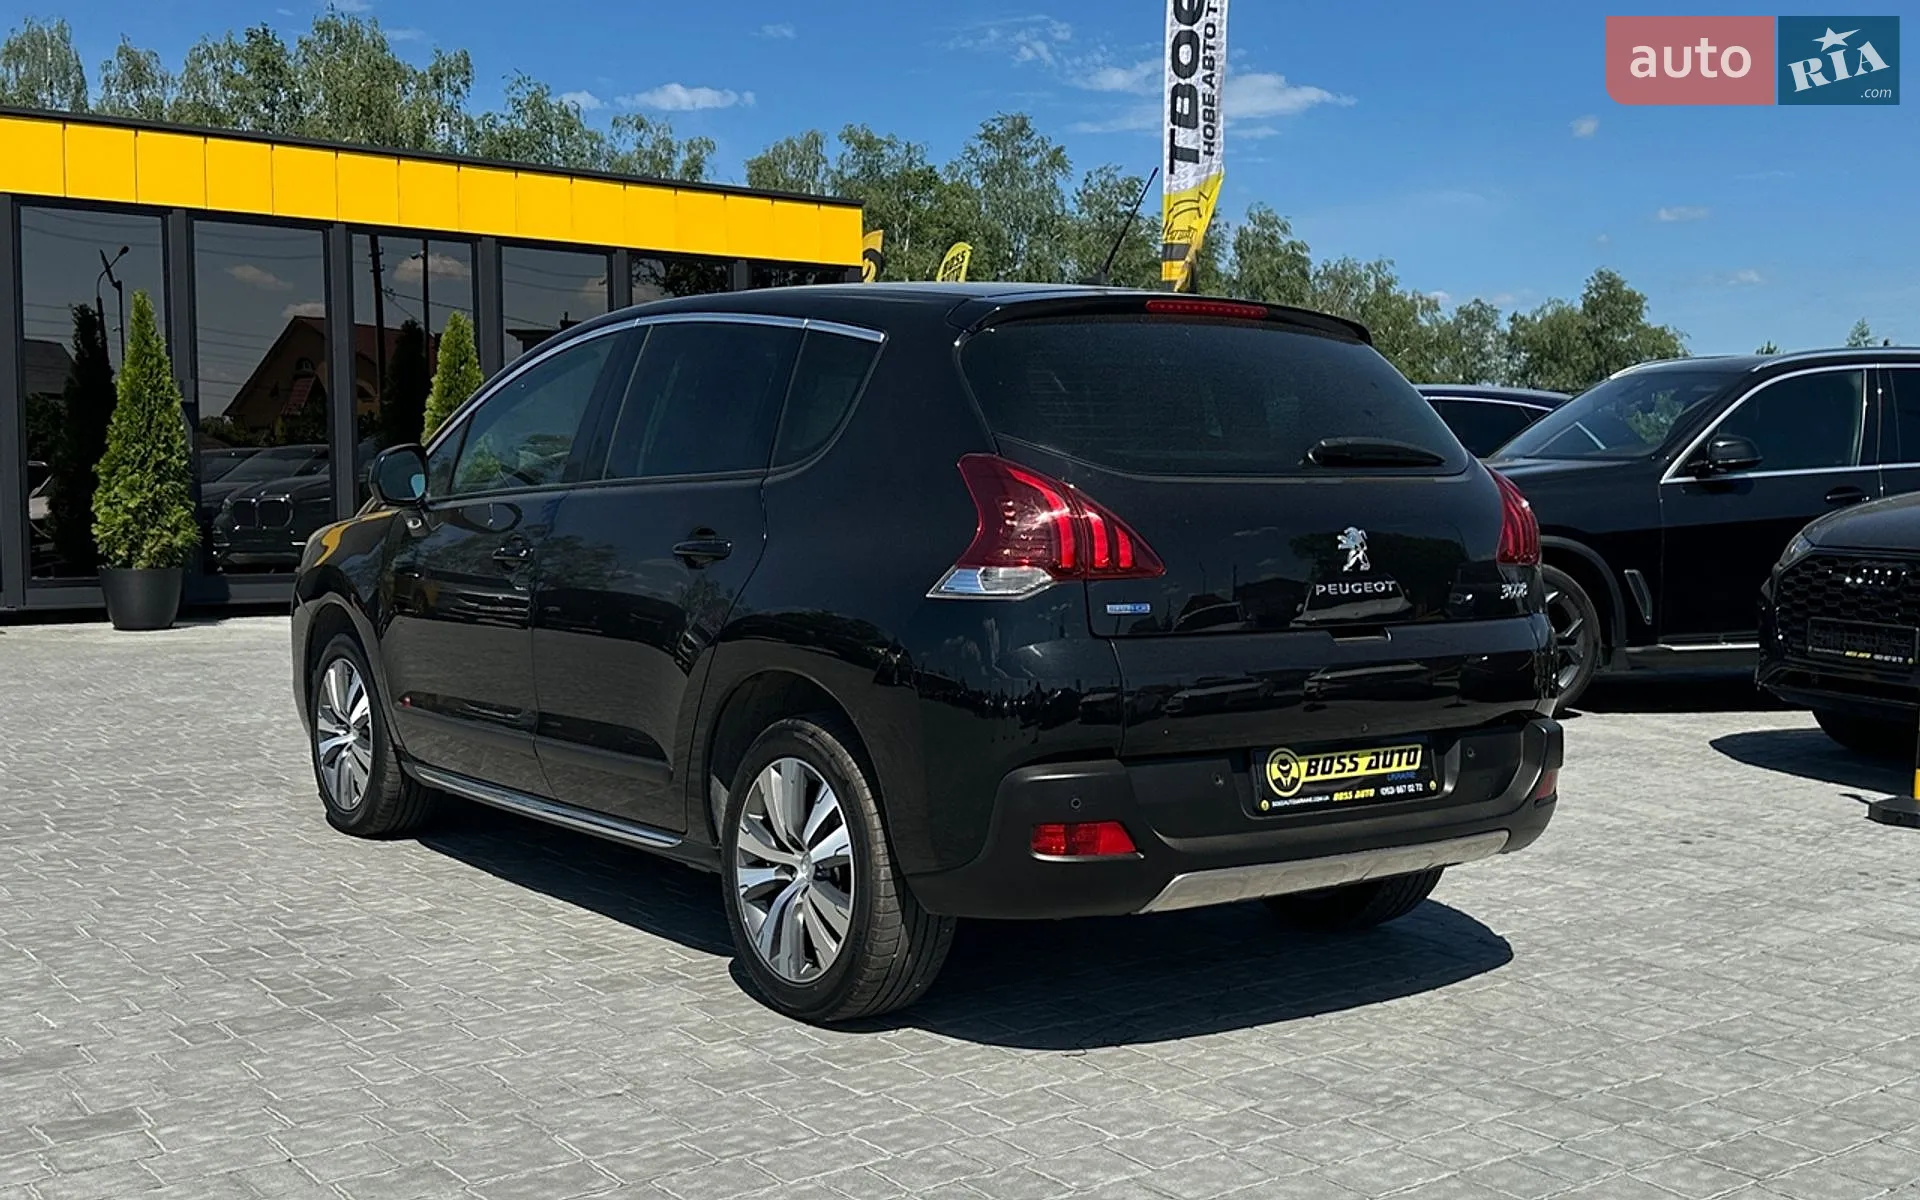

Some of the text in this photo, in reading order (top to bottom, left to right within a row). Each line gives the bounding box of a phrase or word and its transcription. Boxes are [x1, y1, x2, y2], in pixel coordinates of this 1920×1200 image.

[1203, 22, 1217, 89] АВТО
[1202, 93, 1216, 157] НОВЕ
[1315, 580, 1397, 596] PEUGEOT
[1305, 747, 1420, 777] BOSS AUTO
